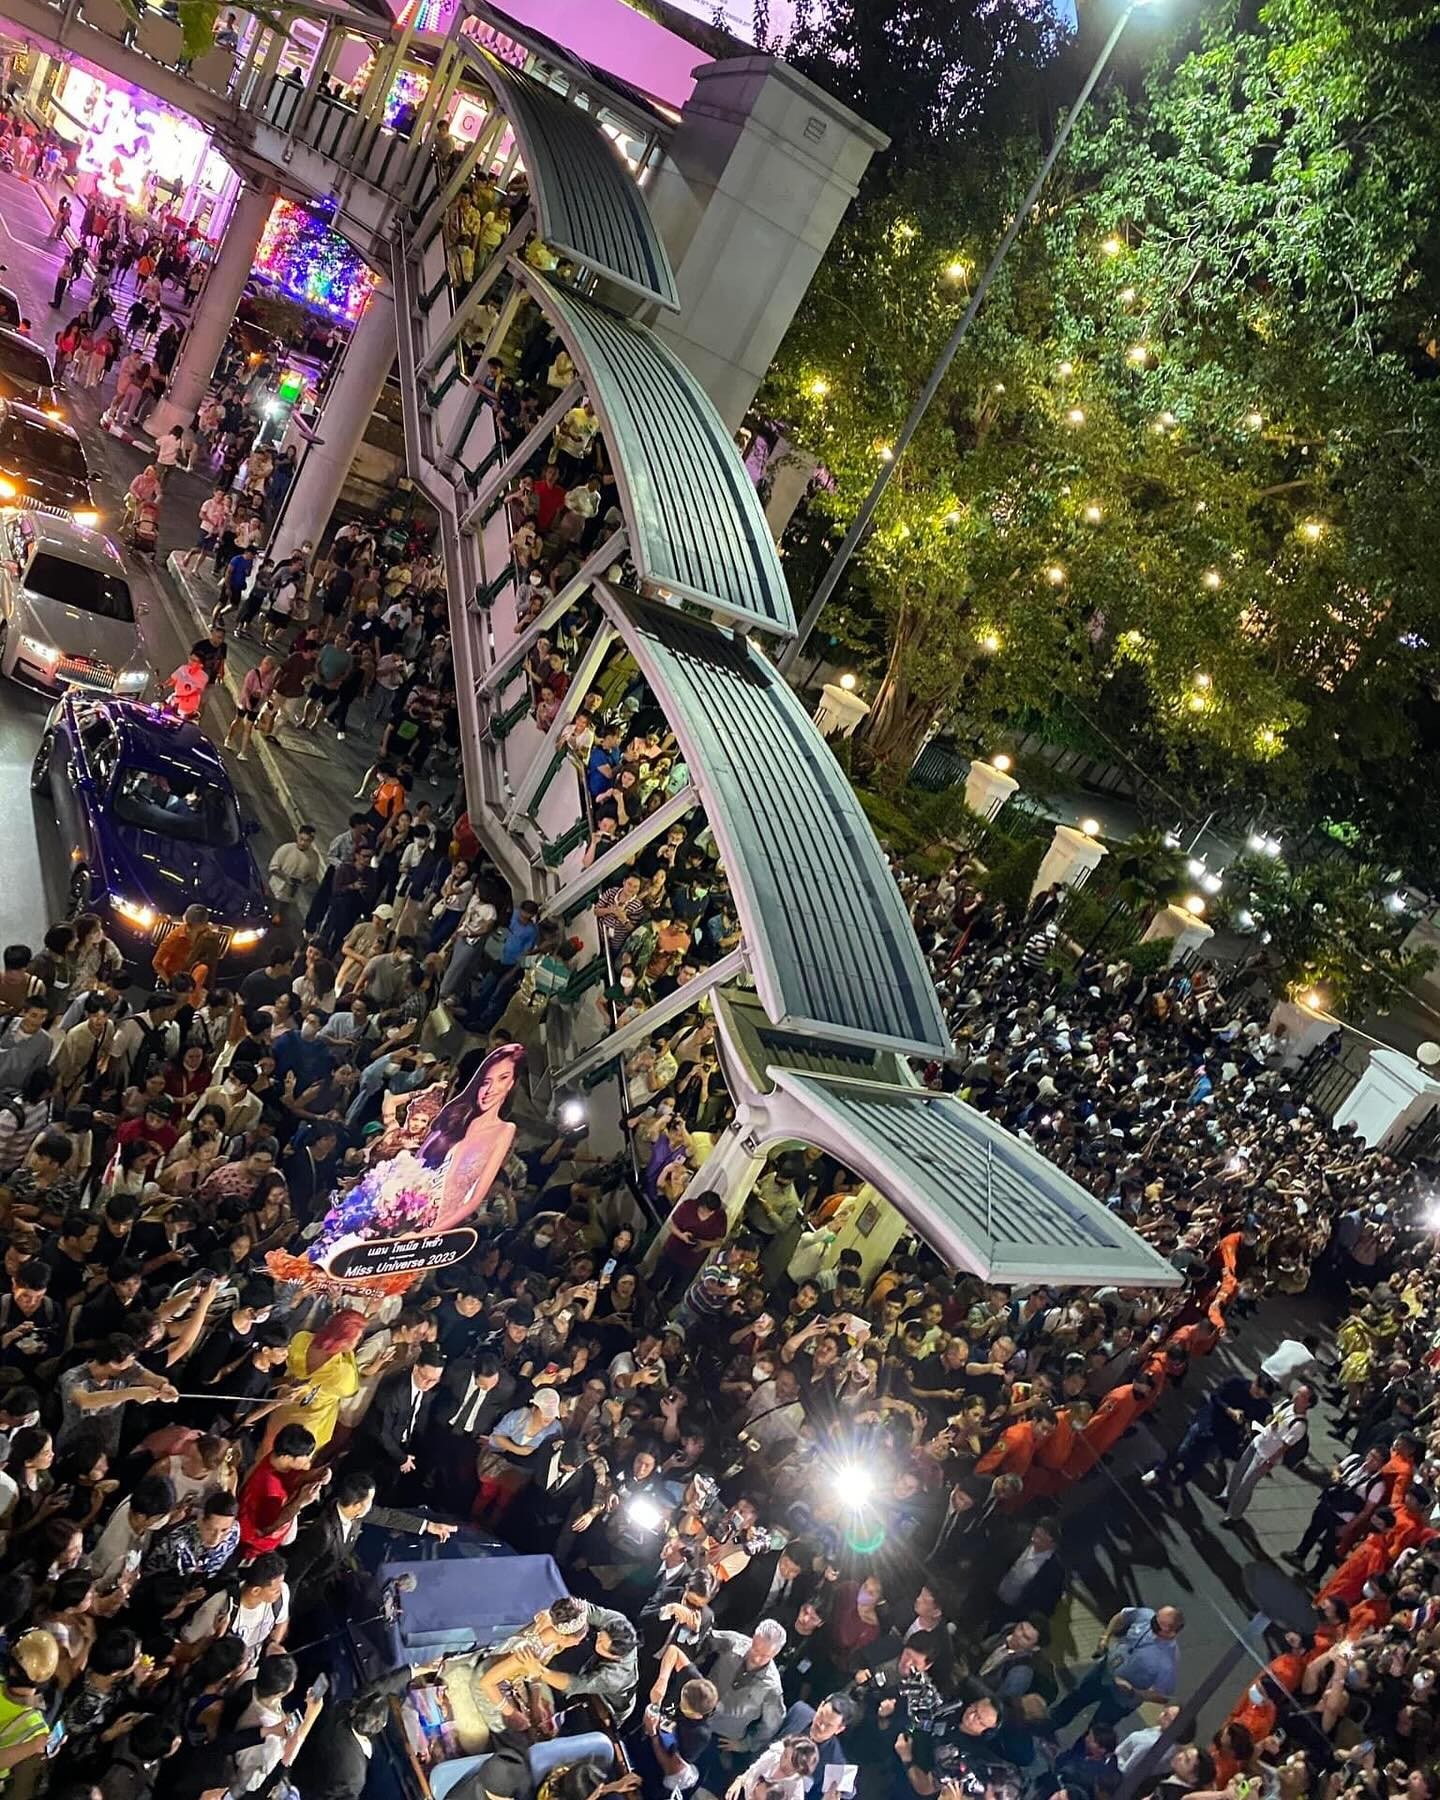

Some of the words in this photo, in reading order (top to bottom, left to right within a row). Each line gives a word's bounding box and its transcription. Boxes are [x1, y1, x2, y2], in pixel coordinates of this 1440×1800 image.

[344, 1265, 373, 1277] Miss
[376, 1258, 424, 1273] Universe
[426, 1250, 456, 1265] 2023
